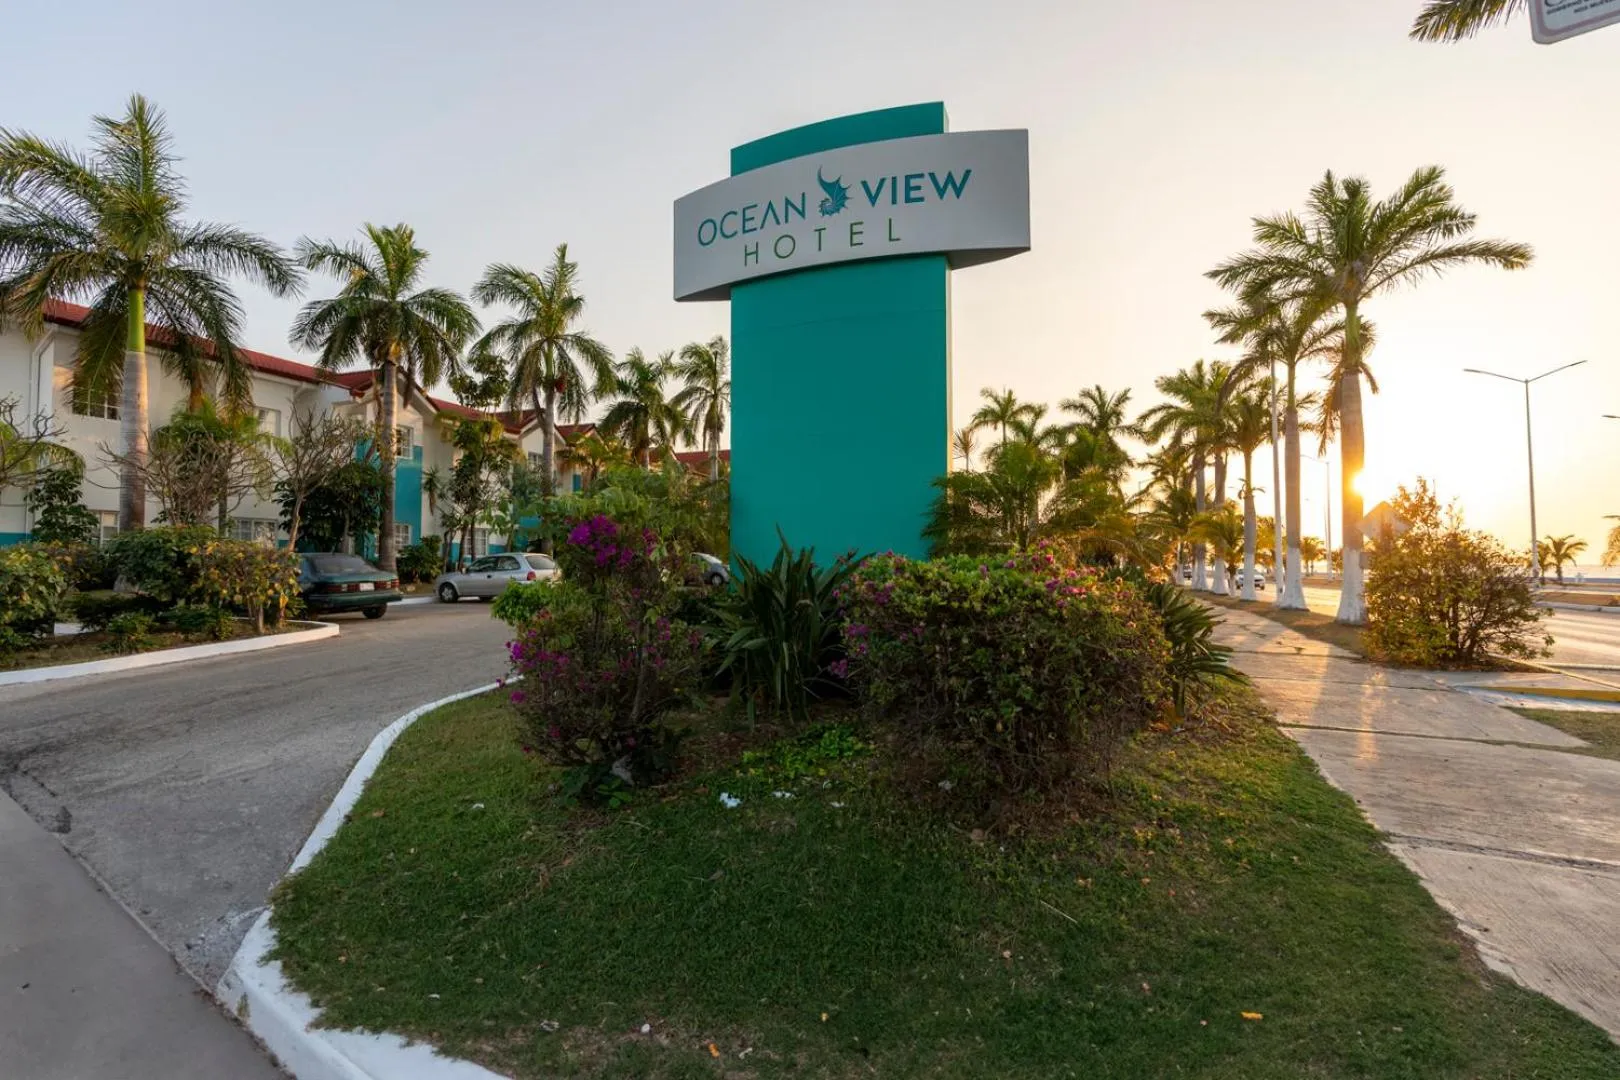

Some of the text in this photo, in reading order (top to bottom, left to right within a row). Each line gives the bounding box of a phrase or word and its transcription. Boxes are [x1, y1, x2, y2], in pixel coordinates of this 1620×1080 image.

[698, 168, 973, 247] OCEAN VIEW
[743, 217, 902, 267] HOTEL
